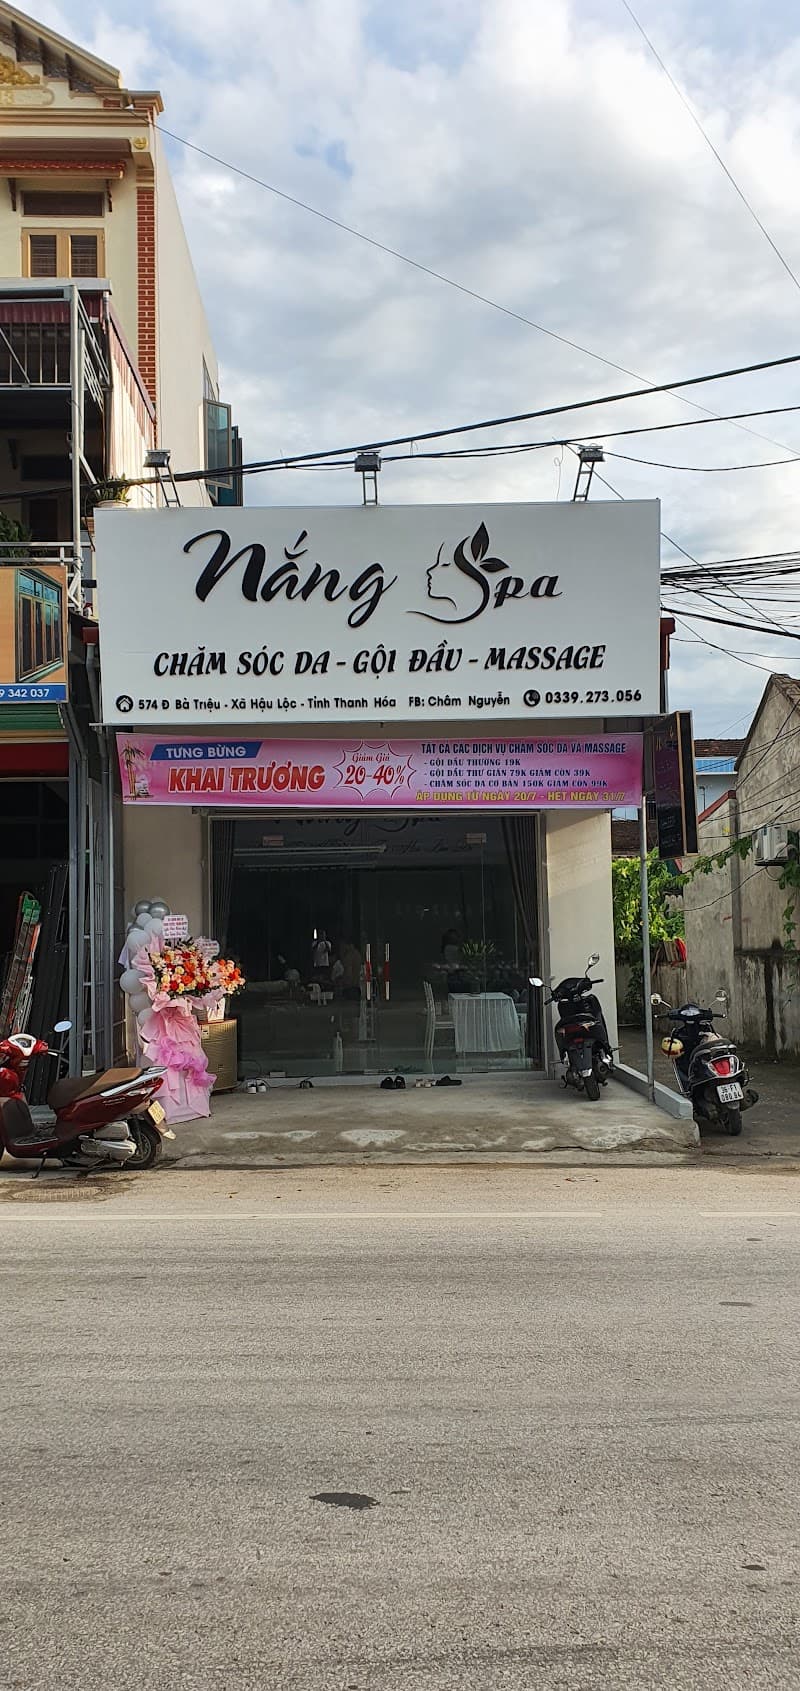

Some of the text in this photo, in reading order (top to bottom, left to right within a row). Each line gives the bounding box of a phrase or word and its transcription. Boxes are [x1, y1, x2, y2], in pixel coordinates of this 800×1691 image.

[183, 529, 563, 628] Nắng Spa
[153, 645, 228, 677] CHĂM
[236, 645, 285, 676] SÓC
[294, 650, 331, 675] DA
[352, 643, 397, 679] GỘI
[408, 639, 464, 673] ĐẦU
[484, 644, 606, 672] MASSAGE
[8, 687, 28, 698] 342
[30, 687, 50, 698] 037
[408, 691, 510, 709] FB: Châm Nguyễn
[545, 689, 642, 704] 0339.273.056
[138, 698, 158, 710] 574
[175, 697, 190, 710] Bà
[194, 698, 221, 713] Triệu
[231, 698, 247, 710] Xã
[250, 697, 273, 713] Hậu
[277, 696, 297, 712] Lộc
[334, 697, 368, 709] Thanh
[374, 695, 397, 709] Hóa
[166, 744, 246, 759] TƯNG BỪNG
[556, 743, 568, 753] DA
[584, 743, 626, 753] MASSAGE
[168, 760, 326, 793] KHAI TRƯƠNG
[344, 764, 407, 785] 20-40%
[509, 769, 527, 777] 79K
[513, 791, 537, 801] 20/7
